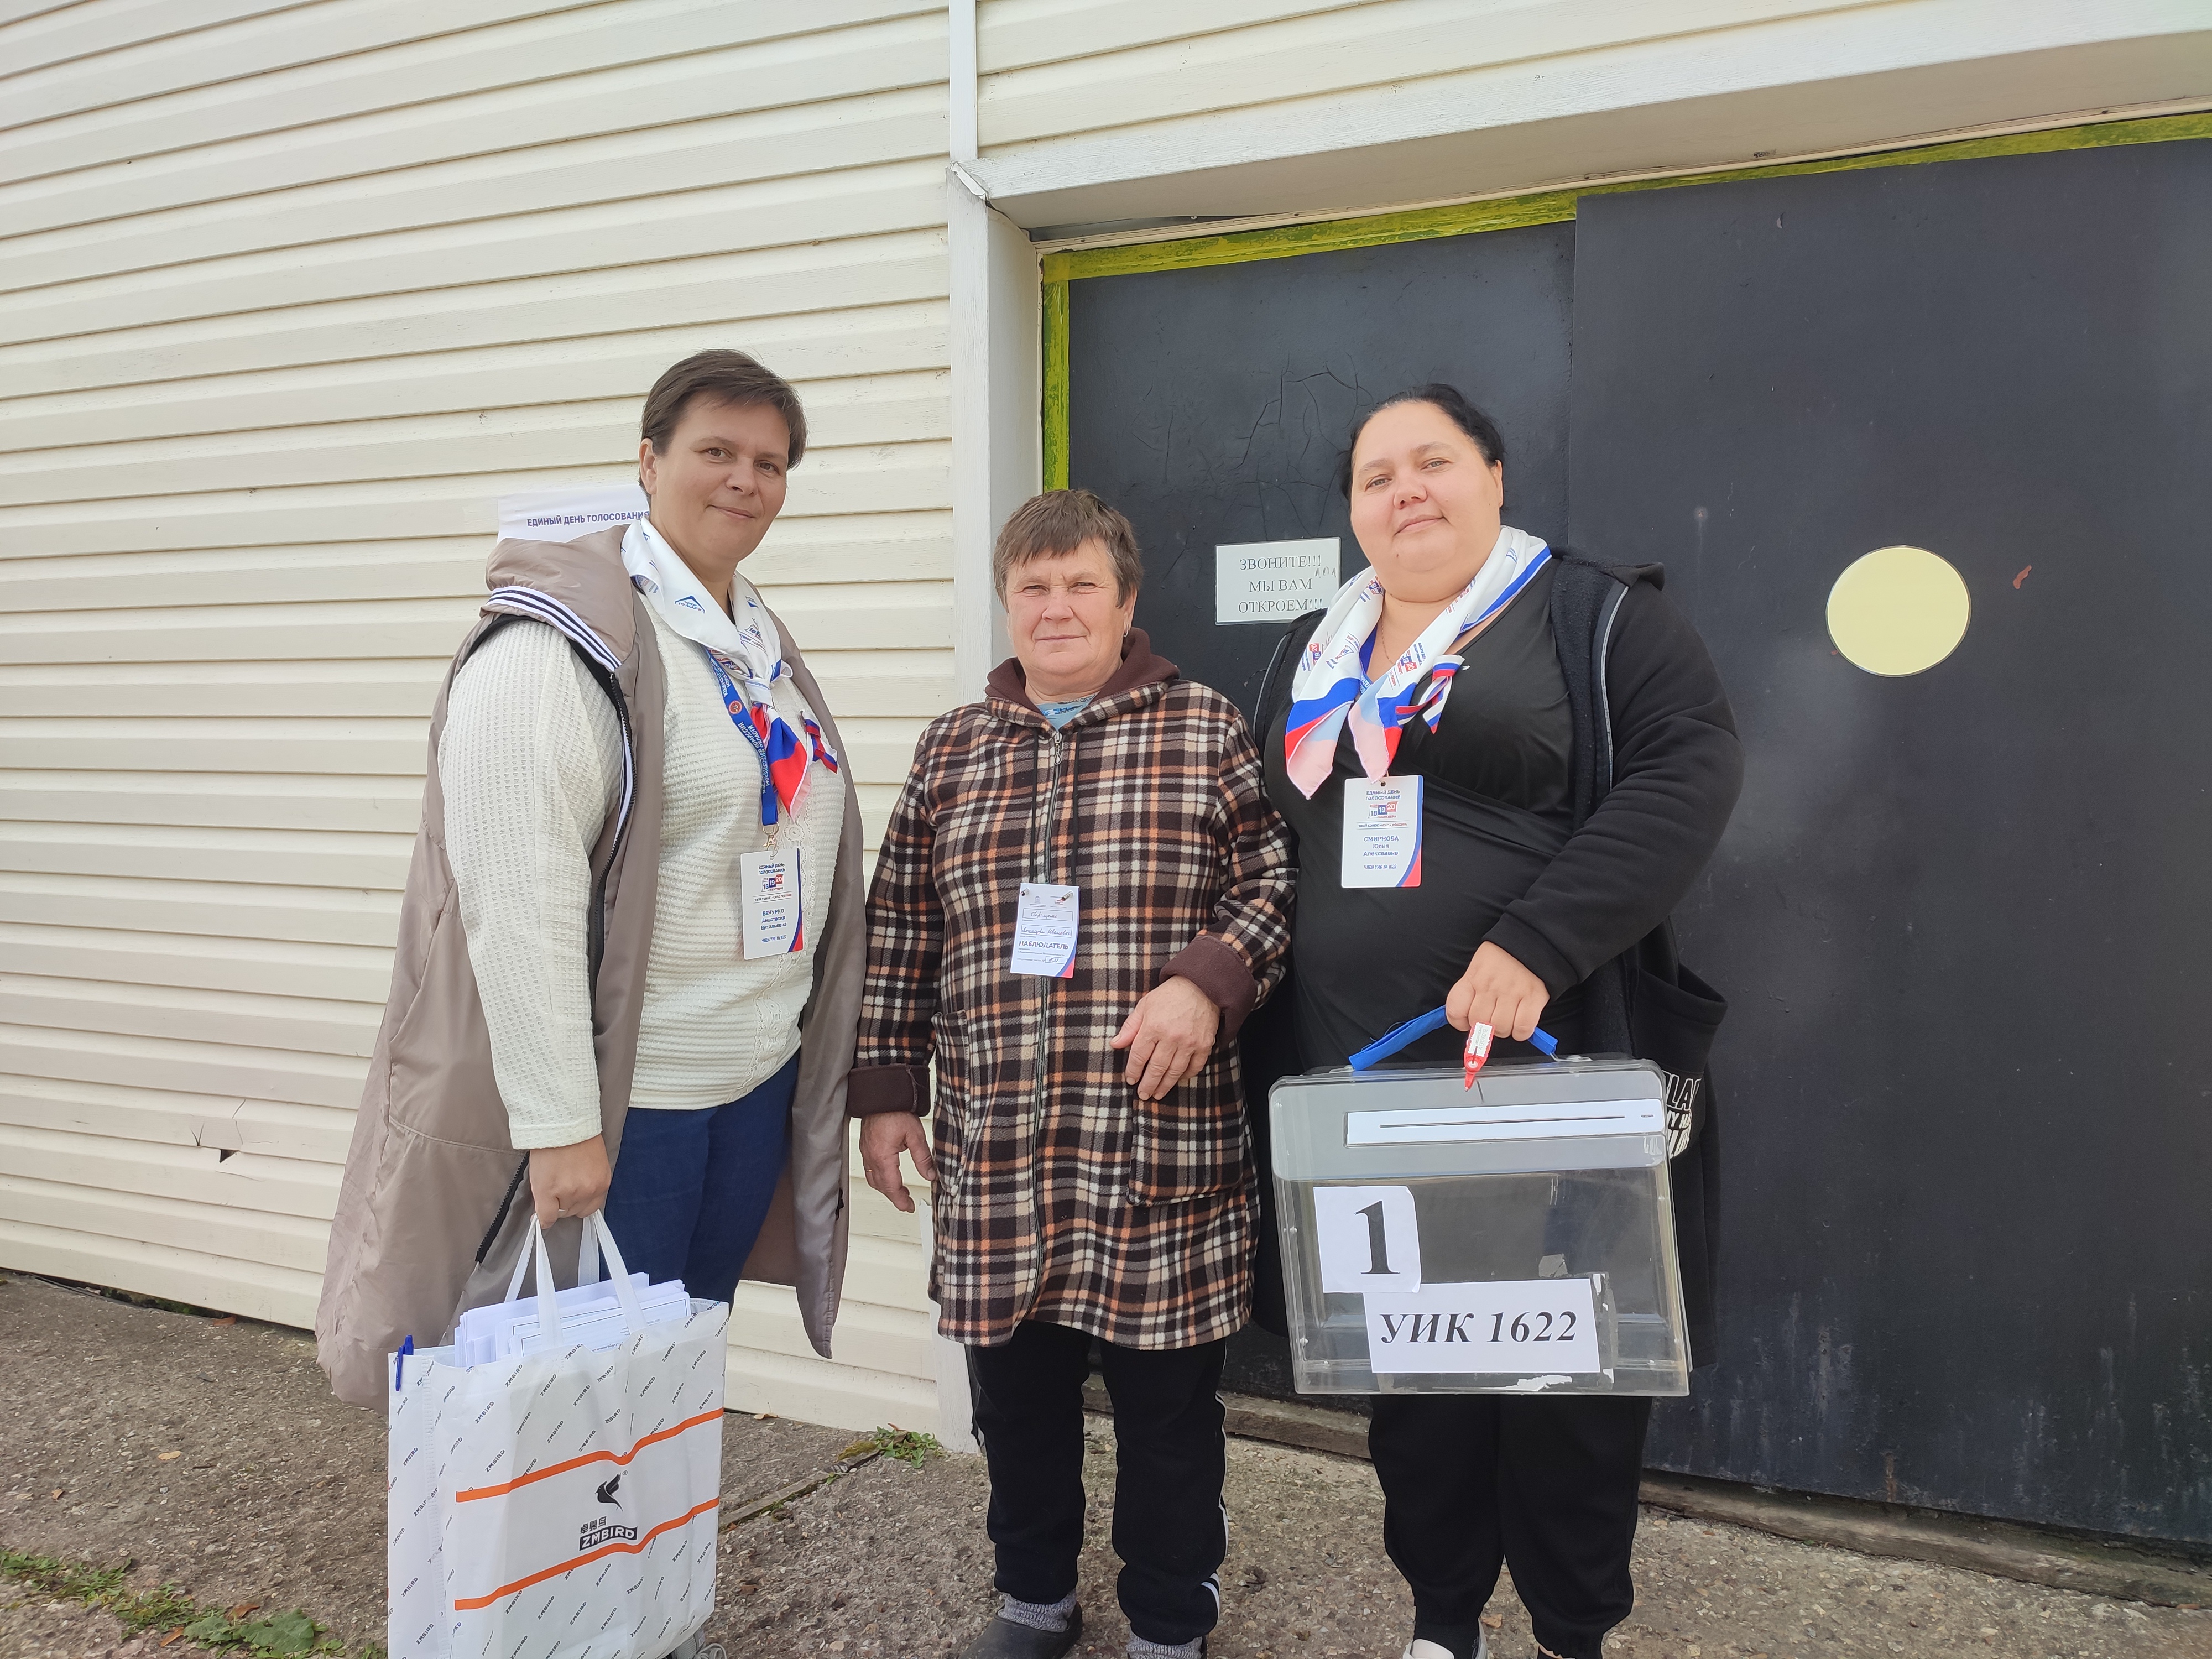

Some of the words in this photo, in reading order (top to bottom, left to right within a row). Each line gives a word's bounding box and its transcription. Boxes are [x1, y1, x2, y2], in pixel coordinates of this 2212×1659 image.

[527, 514, 562, 526] ЕДИНЫЙ
[564, 515, 585, 525] ДЕНЬ
[587, 510, 649, 523] ГОЛОСОВАНИЯ
[1240, 555, 1321, 570] ЗВОНИТЕ!!!
[1249, 580, 1274, 592] МЫ
[1279, 578, 1312, 591] ВАМ
[1238, 598, 1323, 613] ОТКРОЕМ!!!
[1019, 940, 1069, 950] НАБЛЮДАТЕЛЬ
[1354, 1201, 1400, 1275] 1
[1380, 1312, 1475, 1344] УИК
[1490, 1311, 1577, 1343] 1622
[565, 1344, 583, 1360] ZMBIR
[632, 1334, 643, 1355] ZMBIRD
[662, 1342, 675, 1363] ZMBIRD
[692, 1350, 706, 1369] ZMBIRD
[505, 1365, 522, 1387] ZMBIRD
[540, 1374, 556, 1397] ZMBIRD
[573, 1385, 590, 1406] ZMBIRD
[640, 1377, 655, 1397] ZMBIRD
[672, 1383, 684, 1404] ZMBIRD
[398, 1397, 408, 1415] ZMBIRD
[699, 1390, 713, 1410] ZMBIRD
[474, 1402, 494, 1423] ZMBIRD
[516, 1412, 531, 1435] ZMBIRD
[547, 1421, 563, 1443] ZMBIRD
[649, 1418, 665, 1437] MBIRD
[578, 1430, 596, 1453] ZMBIRD
[403, 1448, 418, 1466] ZMBIRD
[485, 1450, 504, 1472] ZMBIRD
[522, 1459, 539, 1478] BIRD
[393, 1528, 404, 1546] ZMBIRD
[582, 1526, 635, 1548] ZMBIRD
[672, 1540, 687, 1562] ZMBIRD
[697, 1542, 711, 1563] ZMBIRD
[596, 1564, 611, 1587] ZMBIRD
[401, 1578, 418, 1597] ZMBIRD
[505, 1590, 523, 1615] ZMBIRD
[538, 1596, 554, 1620] ZMBIRD
[570, 1602, 586, 1625] ZMBIRD
[601, 1608, 617, 1630] ZMBIRD
[416, 1624, 434, 1644] ZMBIRD
[658, 1617, 671, 1639] ZMBIRD
